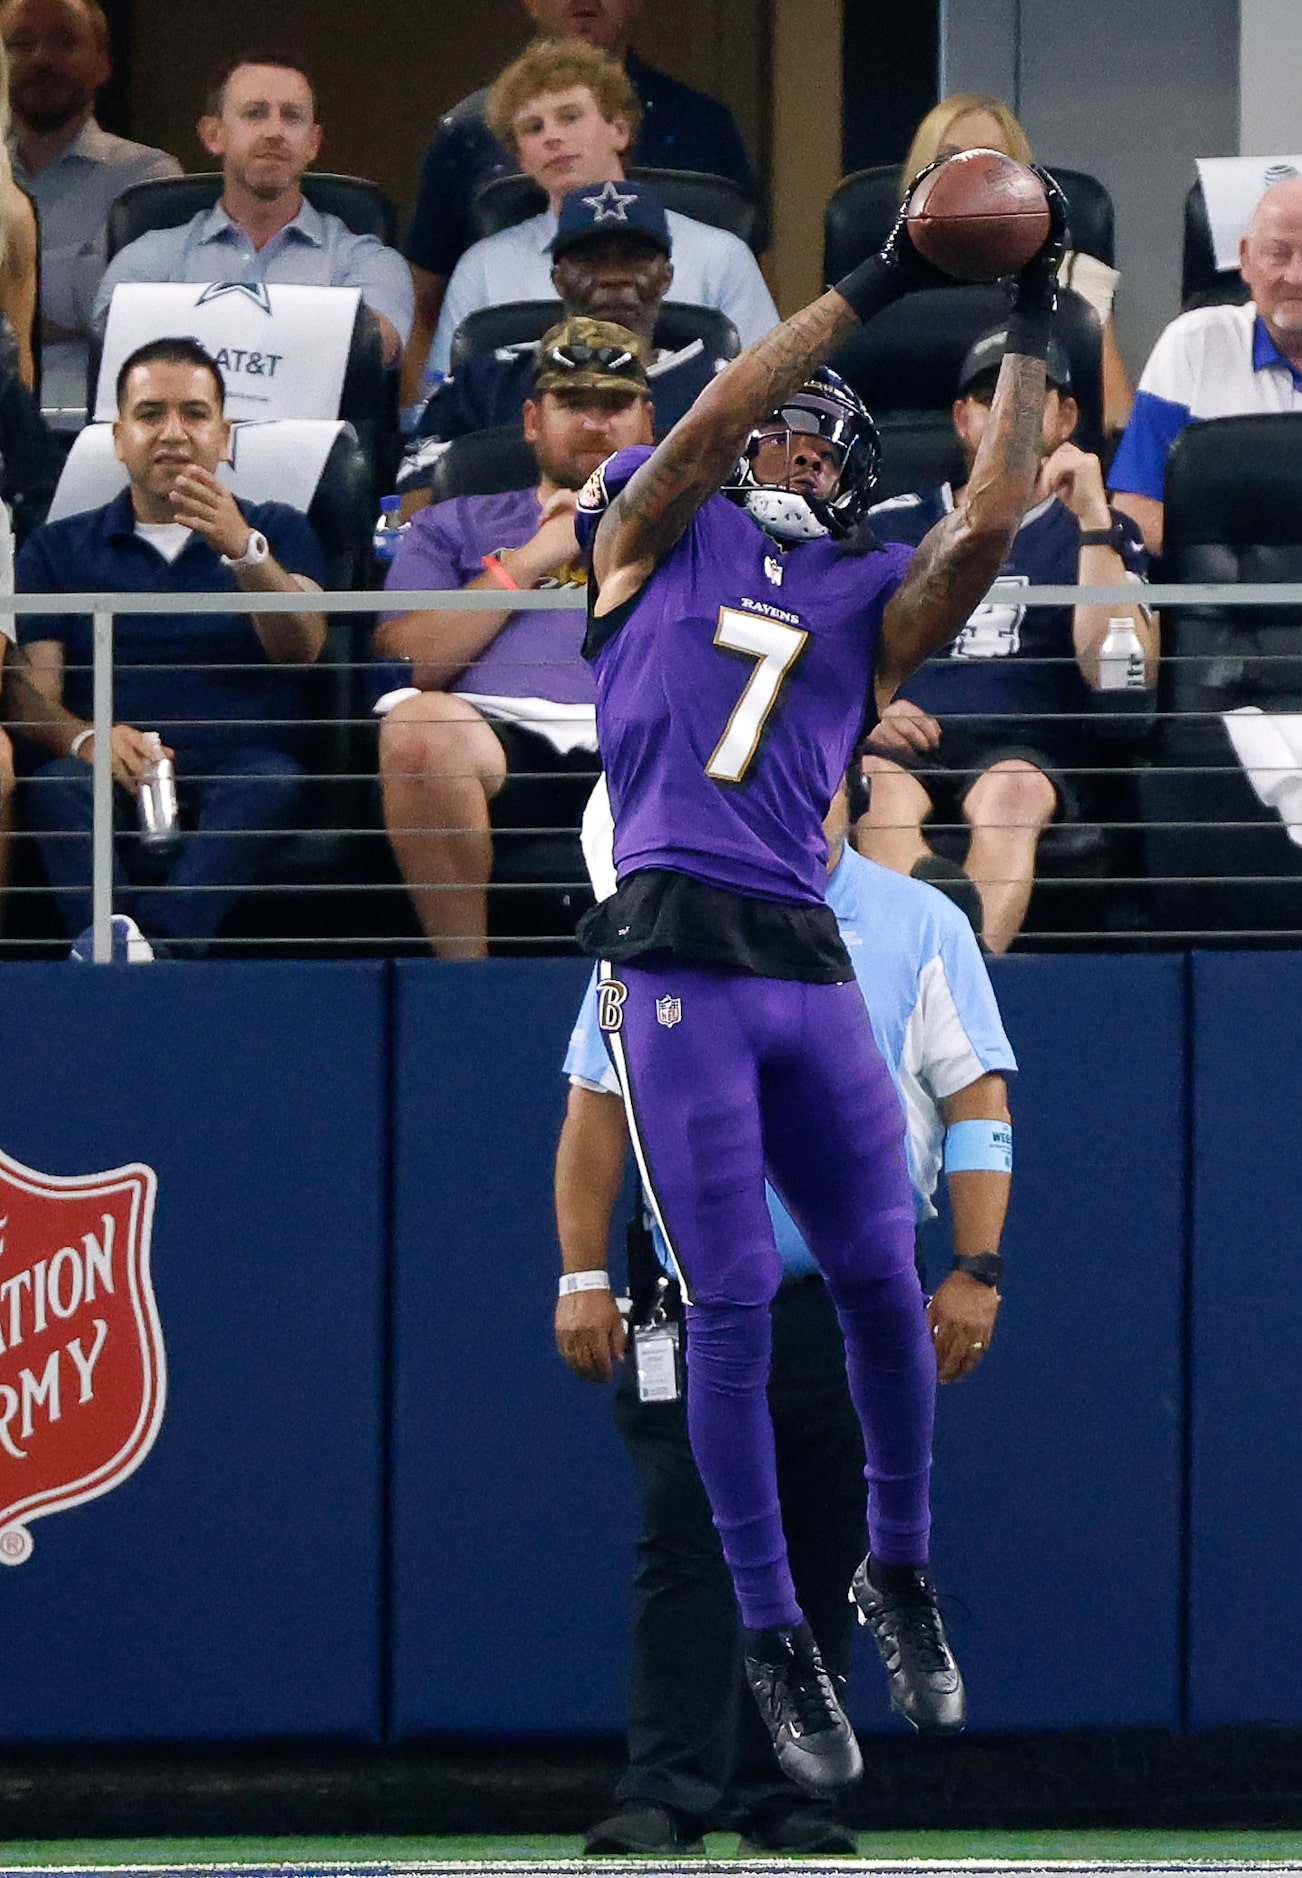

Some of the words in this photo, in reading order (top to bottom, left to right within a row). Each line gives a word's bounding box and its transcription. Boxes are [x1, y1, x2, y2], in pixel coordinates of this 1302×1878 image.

[215, 348, 283, 376] AT&T
[740, 597, 800, 625] RAVENS
[704, 606, 809, 783] 7
